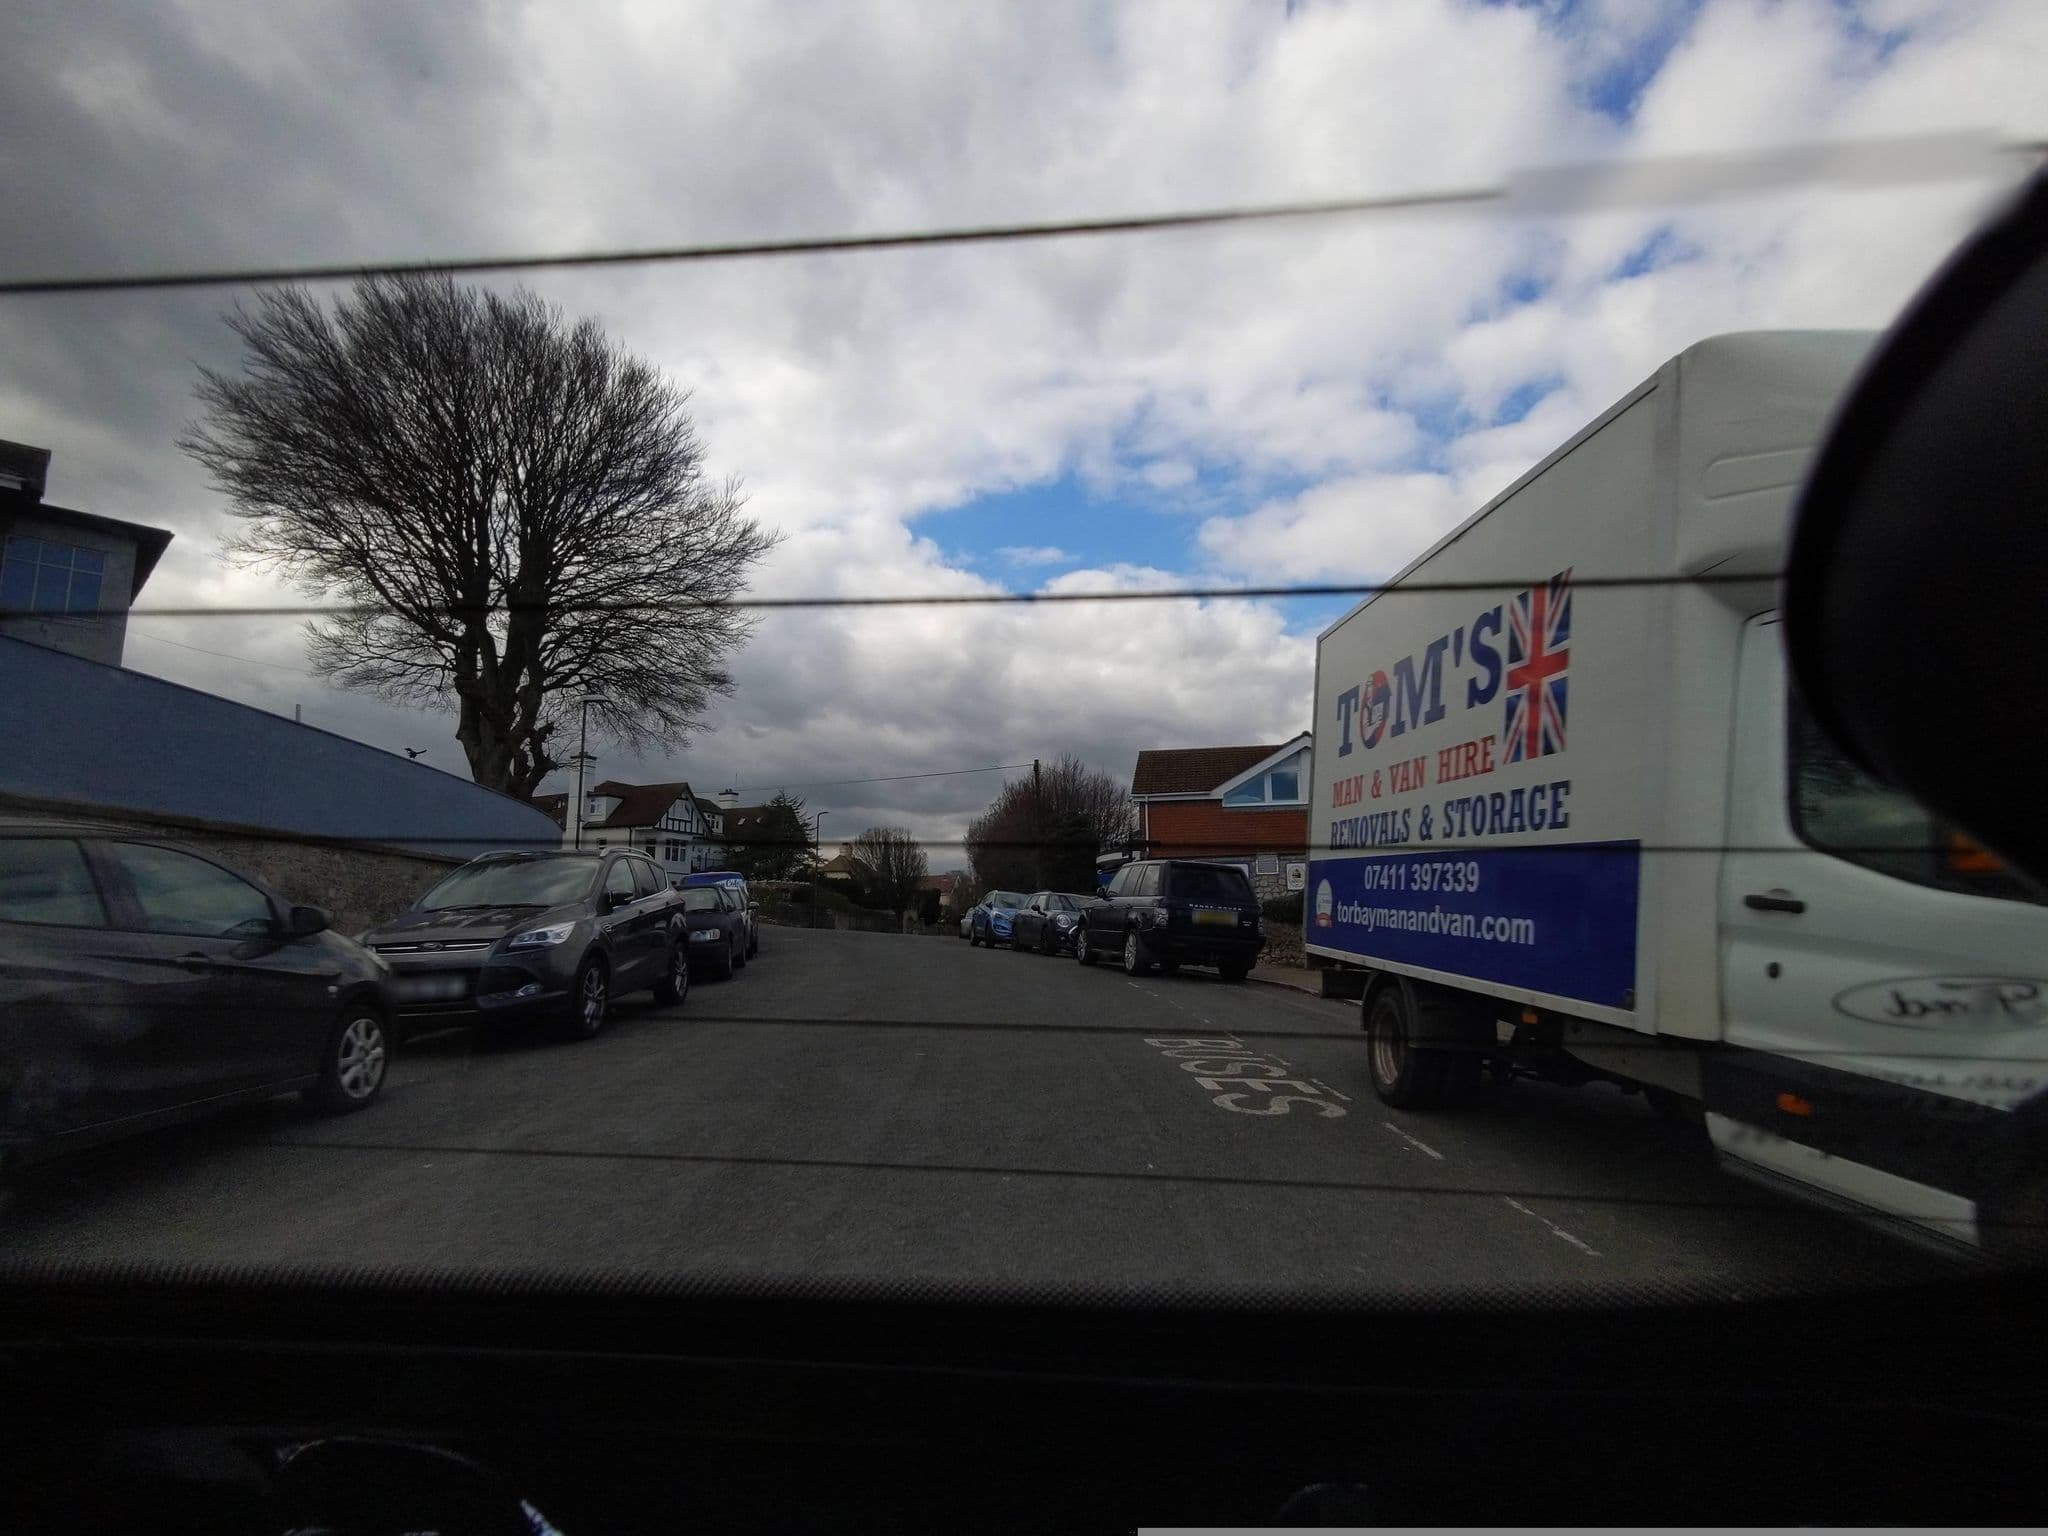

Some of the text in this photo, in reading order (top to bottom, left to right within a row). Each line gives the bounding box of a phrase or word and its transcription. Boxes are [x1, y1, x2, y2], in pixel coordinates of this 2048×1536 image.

[1337, 605, 1502, 757] TOM'S
[1332, 735, 1496, 808] MAN & VAN HIRE
[1329, 779, 1571, 850] REMOVALS & STORAGE
[1364, 861, 1480, 893] 07411 397339
[1337, 900, 1536, 945] torbaymanandvan.com
[1143, 1038, 1347, 1118] BUSES
